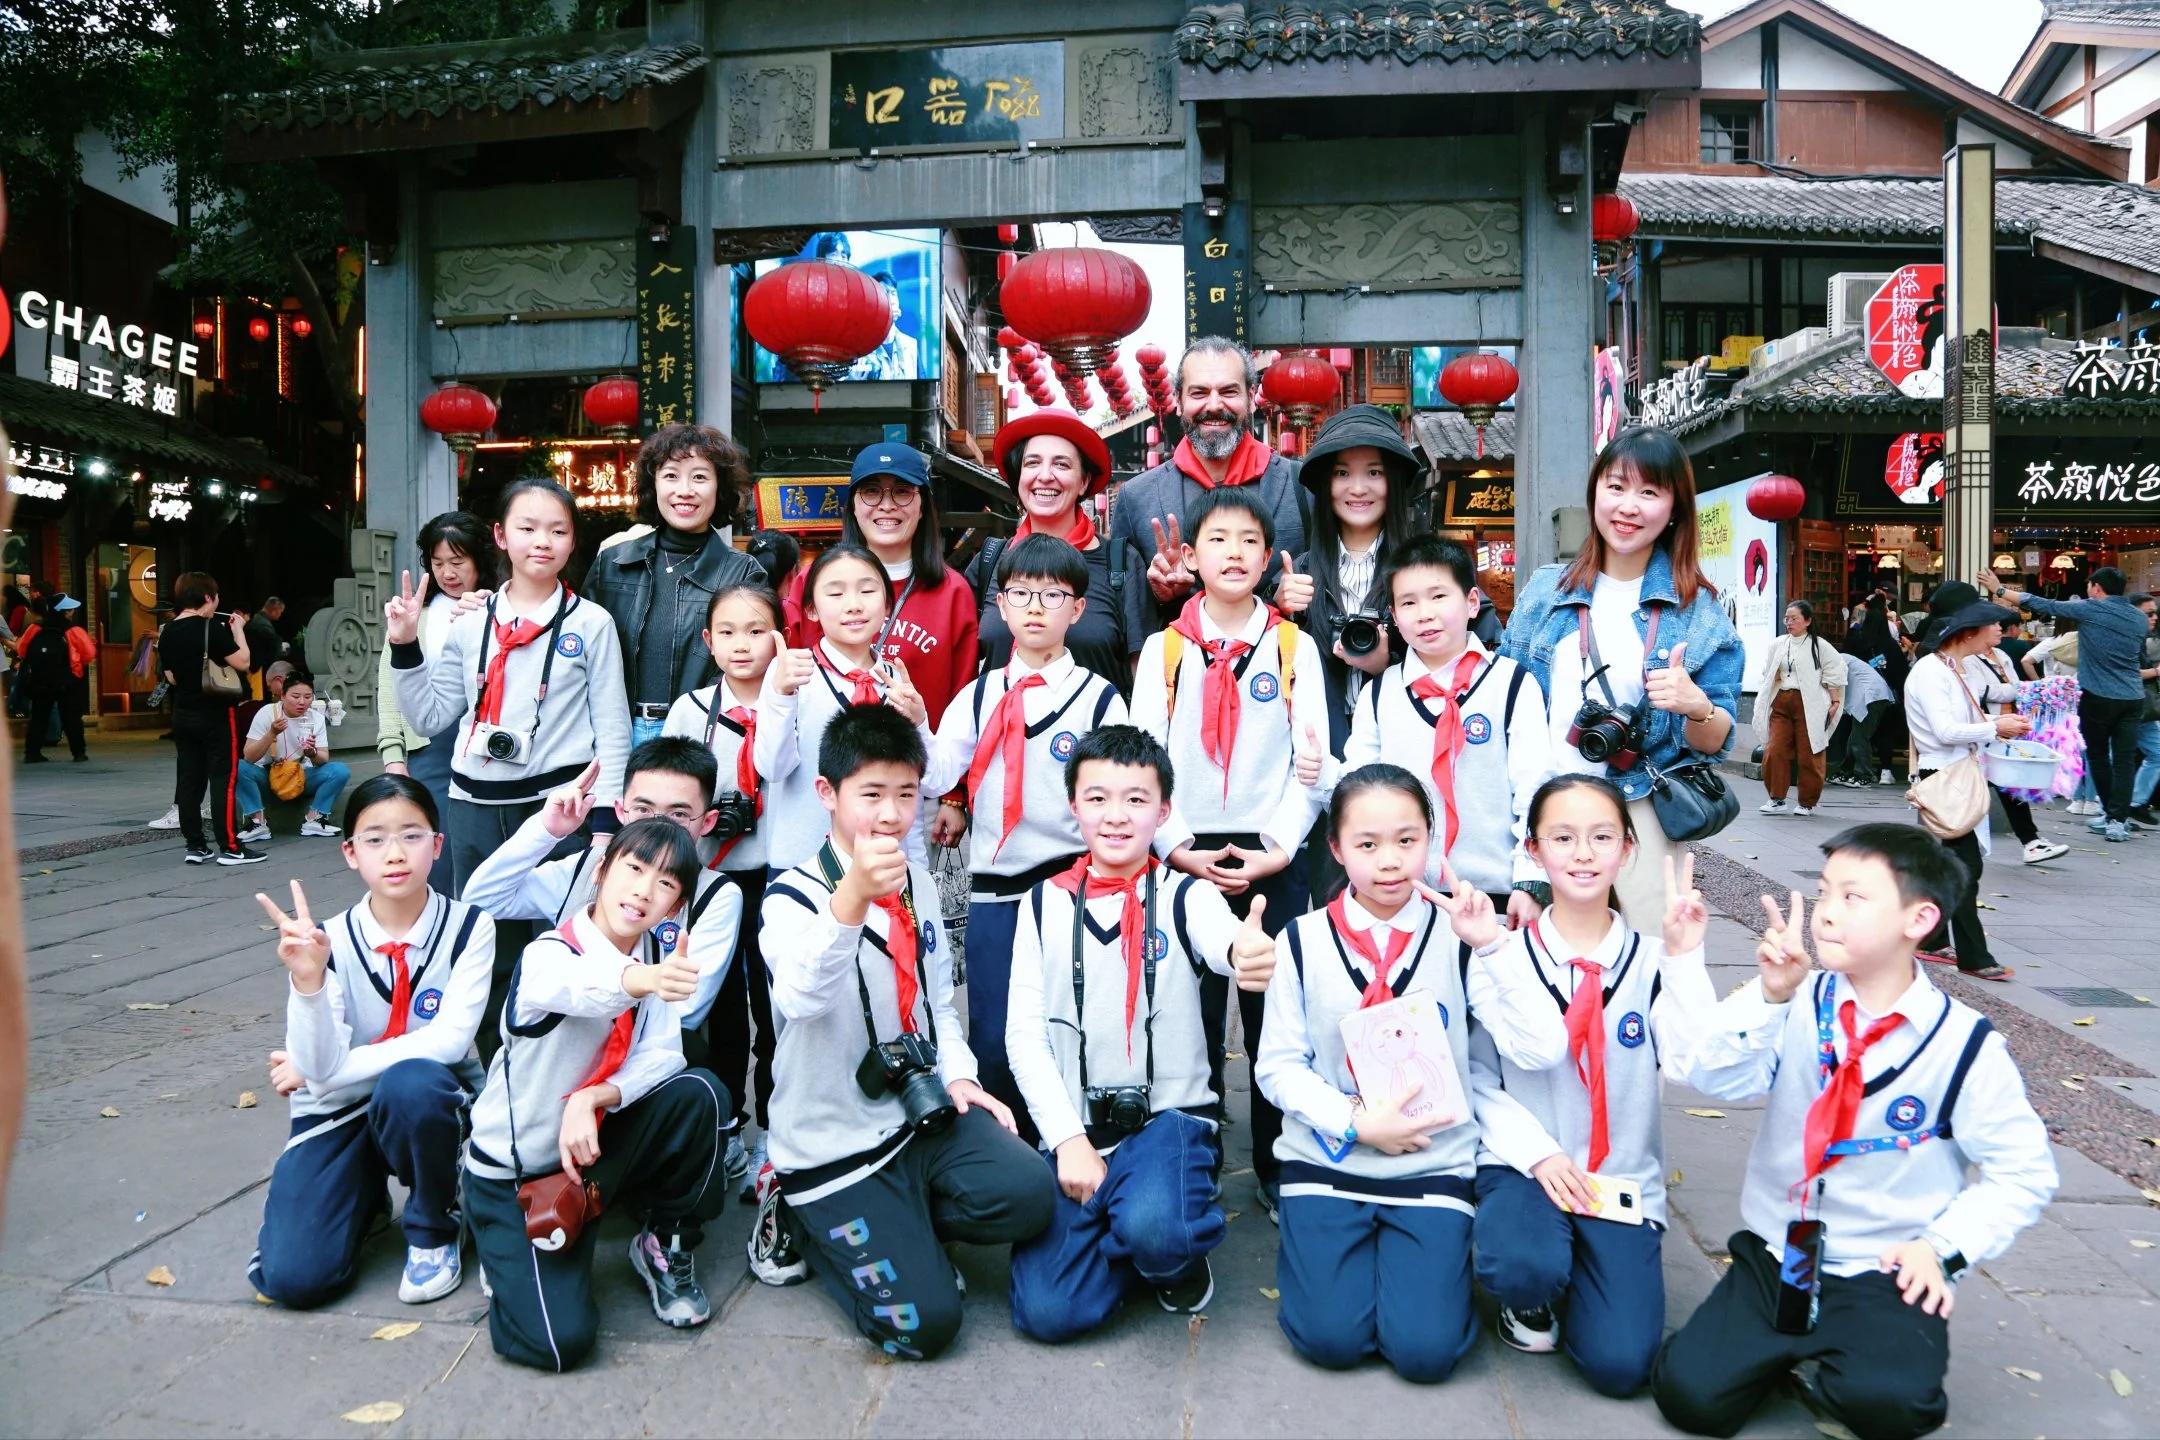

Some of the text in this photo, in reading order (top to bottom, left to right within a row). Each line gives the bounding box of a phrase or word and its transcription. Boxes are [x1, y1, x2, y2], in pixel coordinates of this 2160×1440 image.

[19, 291, 199, 376] CHAGEE
[50, 354, 178, 416] 霸王茶姬
[556, 461, 638, 494] 小城
[888, 644, 901, 656] OF
